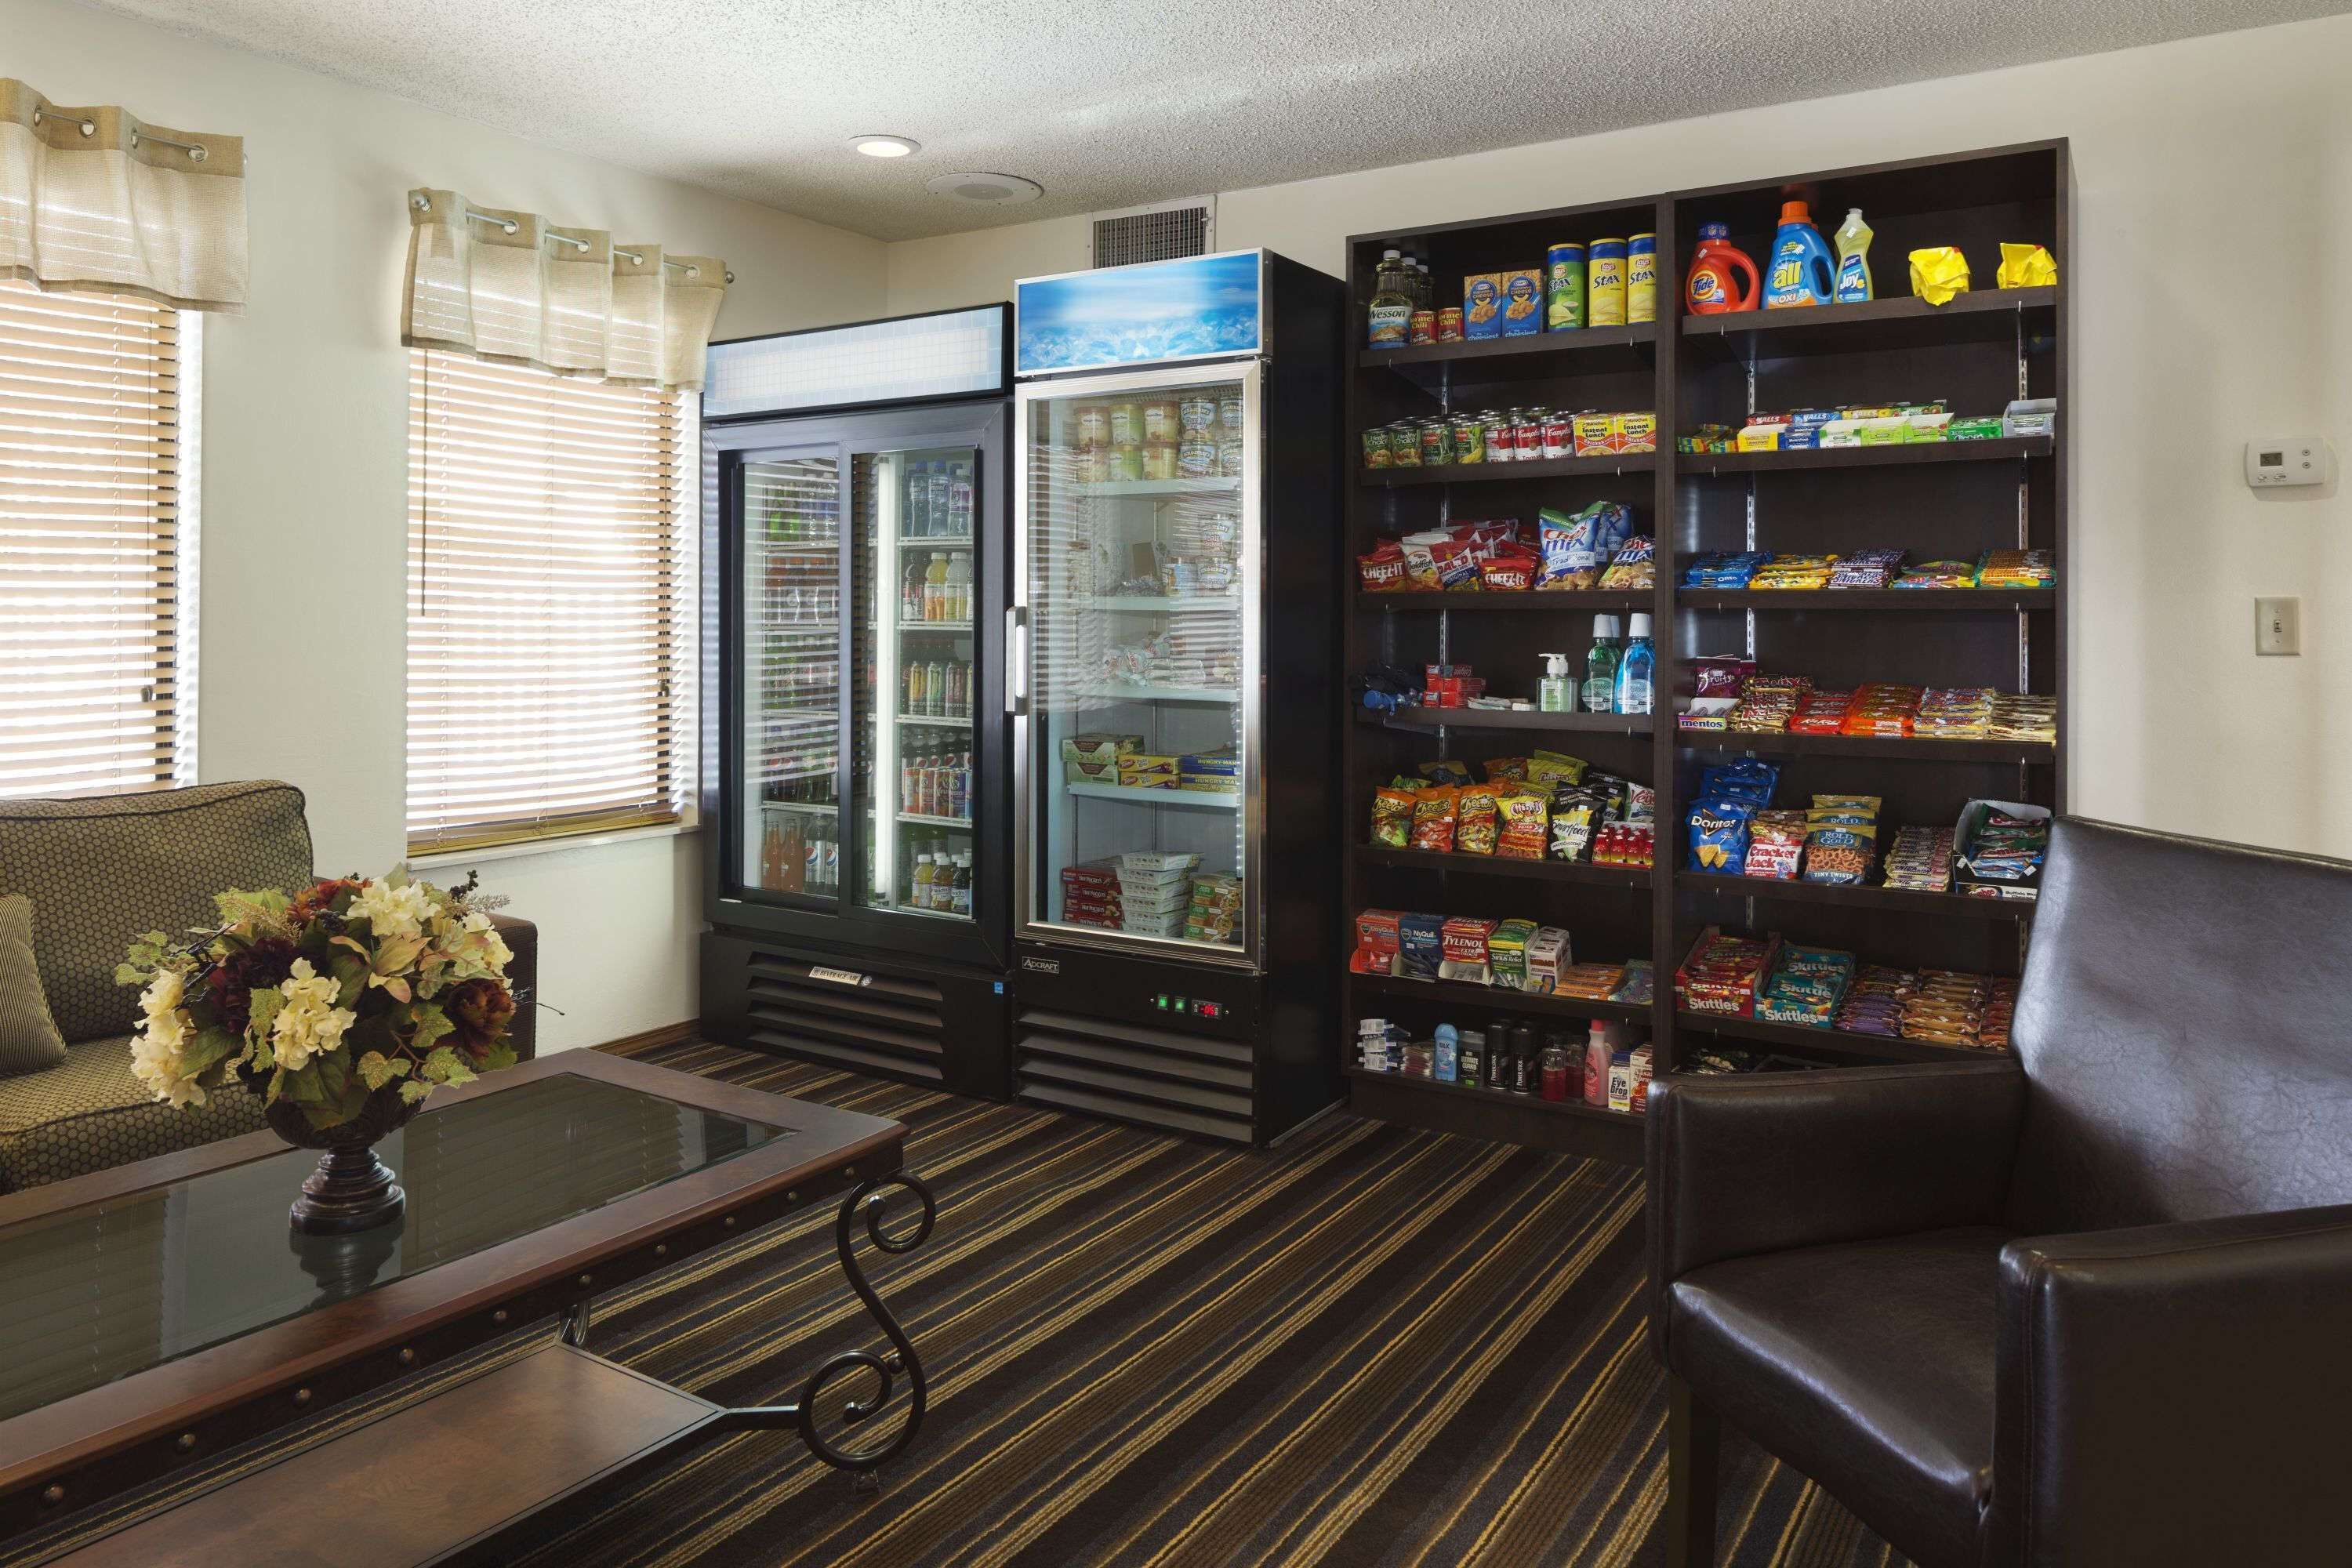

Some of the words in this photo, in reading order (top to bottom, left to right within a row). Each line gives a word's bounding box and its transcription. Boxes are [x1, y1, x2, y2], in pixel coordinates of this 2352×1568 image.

[1773, 261, 1802, 289] all
[1693, 278, 1715, 295] Tide
[1840, 274, 1858, 290] Joy
[1369, 309, 1406, 320] Wesson
[1803, 413, 1828, 422] HALLS
[1518, 427, 1541, 438] Campb
[1548, 426, 1572, 437] Campb
[1437, 555, 1468, 575] DAVD
[1552, 554, 1590, 564] Tradonal
[1363, 562, 1403, 579] CHEEZ-IT
[1681, 719, 1723, 728] mentos
[1416, 800, 1450, 816] Cheetos
[1553, 818, 1591, 837] Smartfood
[1690, 815, 1737, 829] Doritos
[1825, 831, 1853, 840] ROLD
[1749, 845, 1796, 859] Cracker
[1746, 857, 1777, 869] Jack
[1414, 929, 1434, 939] NyQuil
[1443, 935, 1483, 949] TYLENOL
[1492, 953, 1507, 962] Sinus
[1024, 959, 1058, 971] ADCRAFT
[1788, 962, 1845, 973] Skittles
[1779, 983, 1831, 999] Skittle
[1689, 997, 1740, 1011] Skittles
[1764, 1008, 1818, 1024] Skittles
[1612, 1076, 1627, 1087] Eye
[1610, 1085, 1628, 1095] Drop
